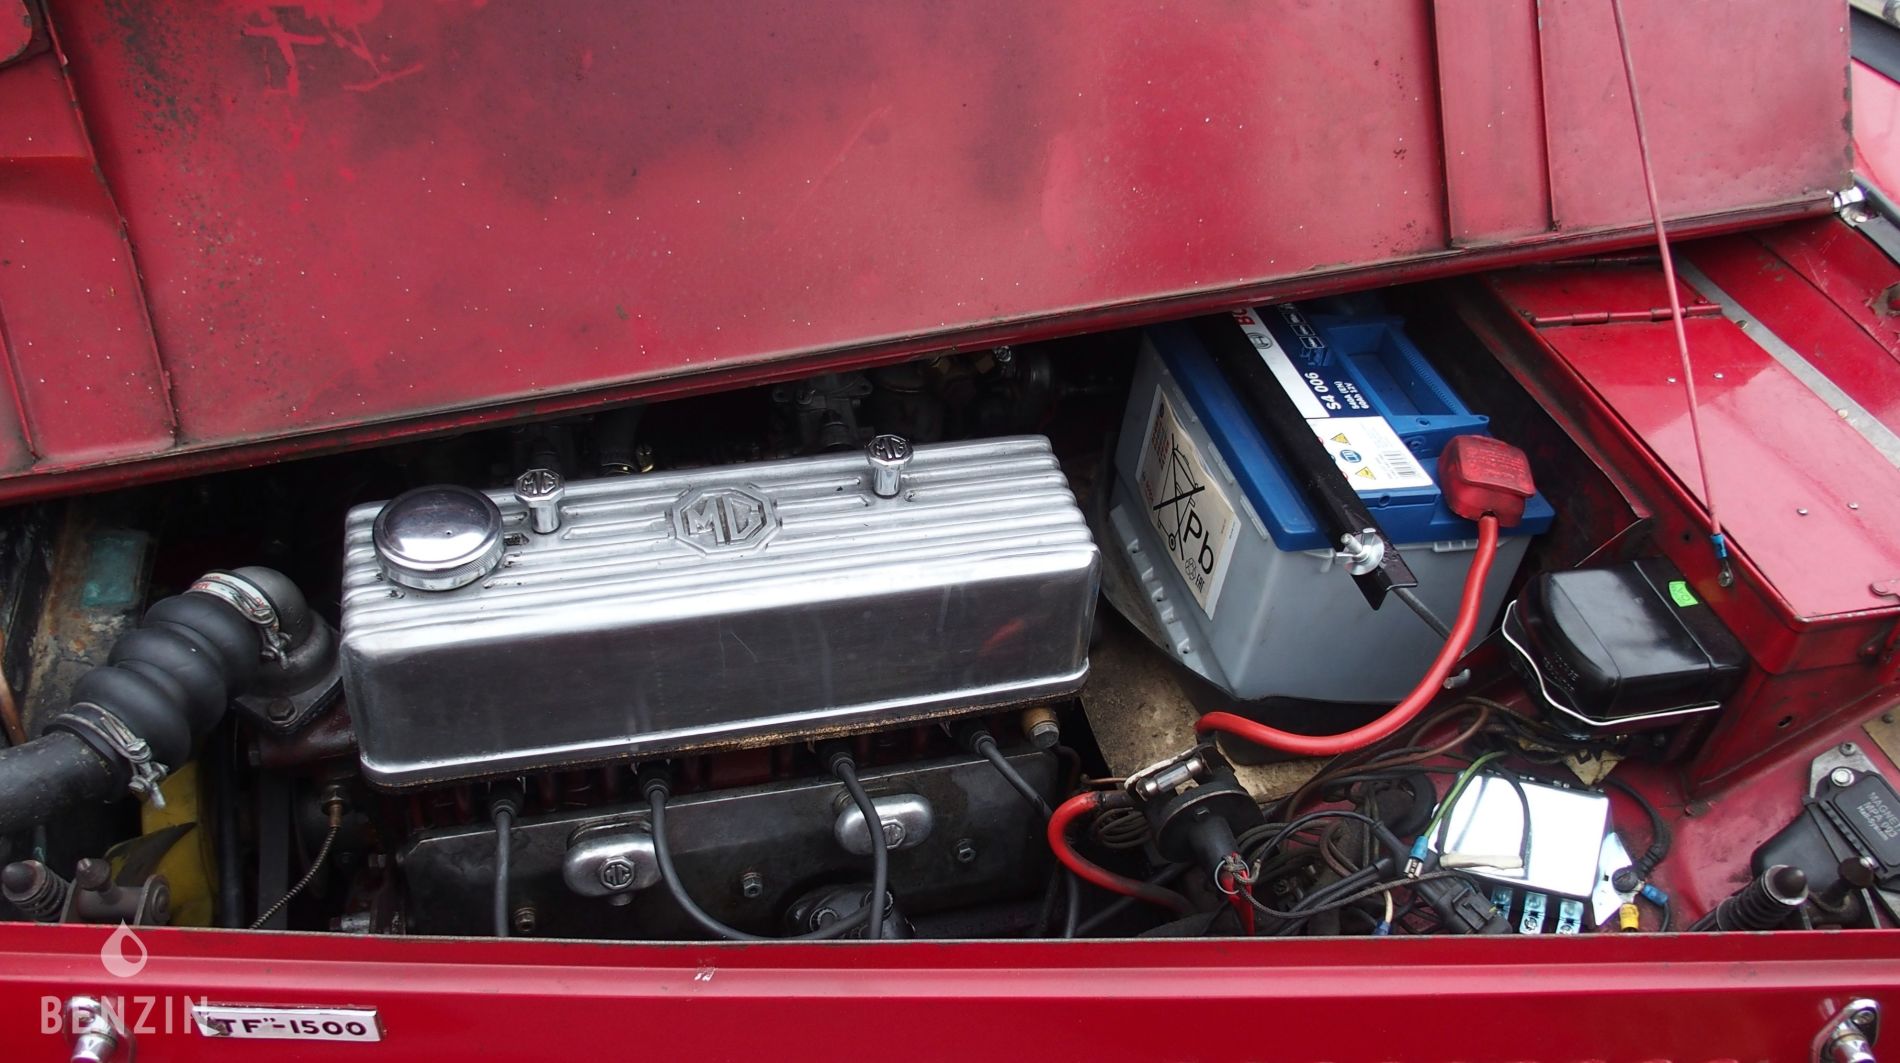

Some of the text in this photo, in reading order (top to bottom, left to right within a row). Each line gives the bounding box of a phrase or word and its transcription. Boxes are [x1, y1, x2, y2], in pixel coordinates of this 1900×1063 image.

[1304, 372, 1342, 410] S4 006
[872, 437, 905, 460] MG
[521, 472, 557, 495] MG
[681, 492, 765, 544] MG
[1183, 508, 1214, 575] Pb
[603, 863, 632, 887] MG
